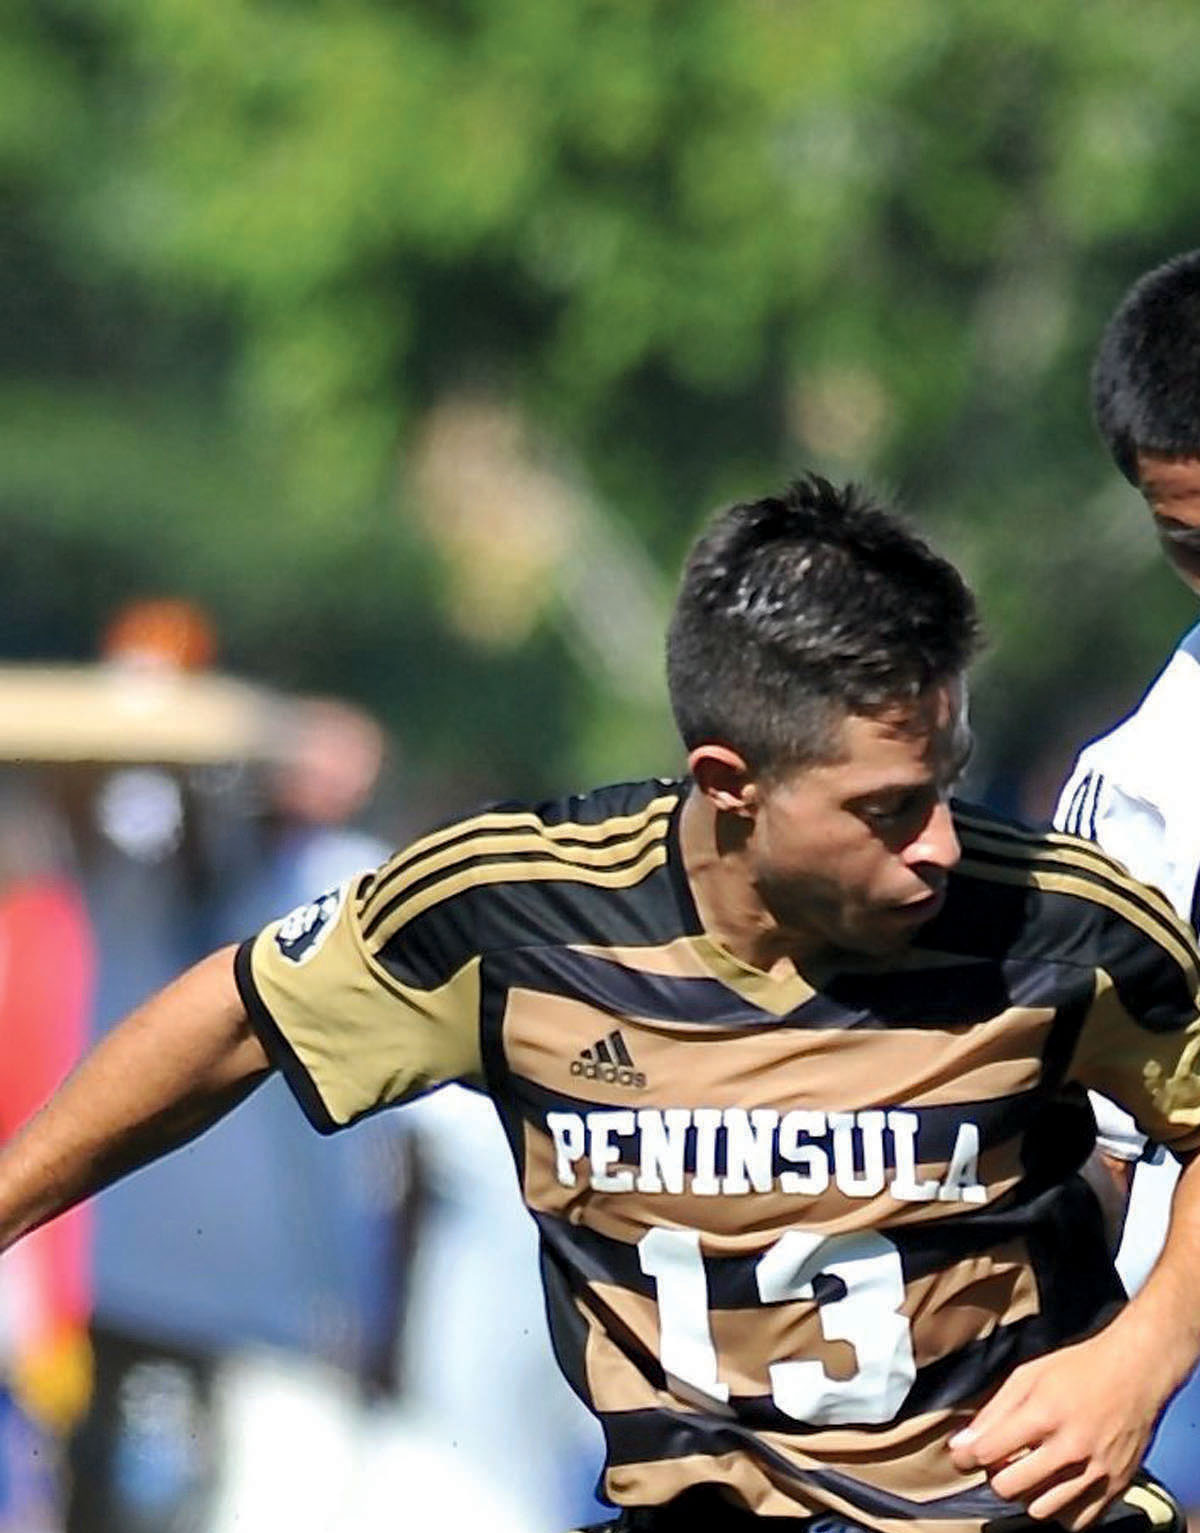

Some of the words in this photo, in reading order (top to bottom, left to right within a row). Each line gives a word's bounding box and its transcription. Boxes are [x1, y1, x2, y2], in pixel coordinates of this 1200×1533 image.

[570, 1061, 647, 1088] adidas
[546, 1107, 988, 1203] PENINSULA
[637, 1226, 917, 1426] 13
